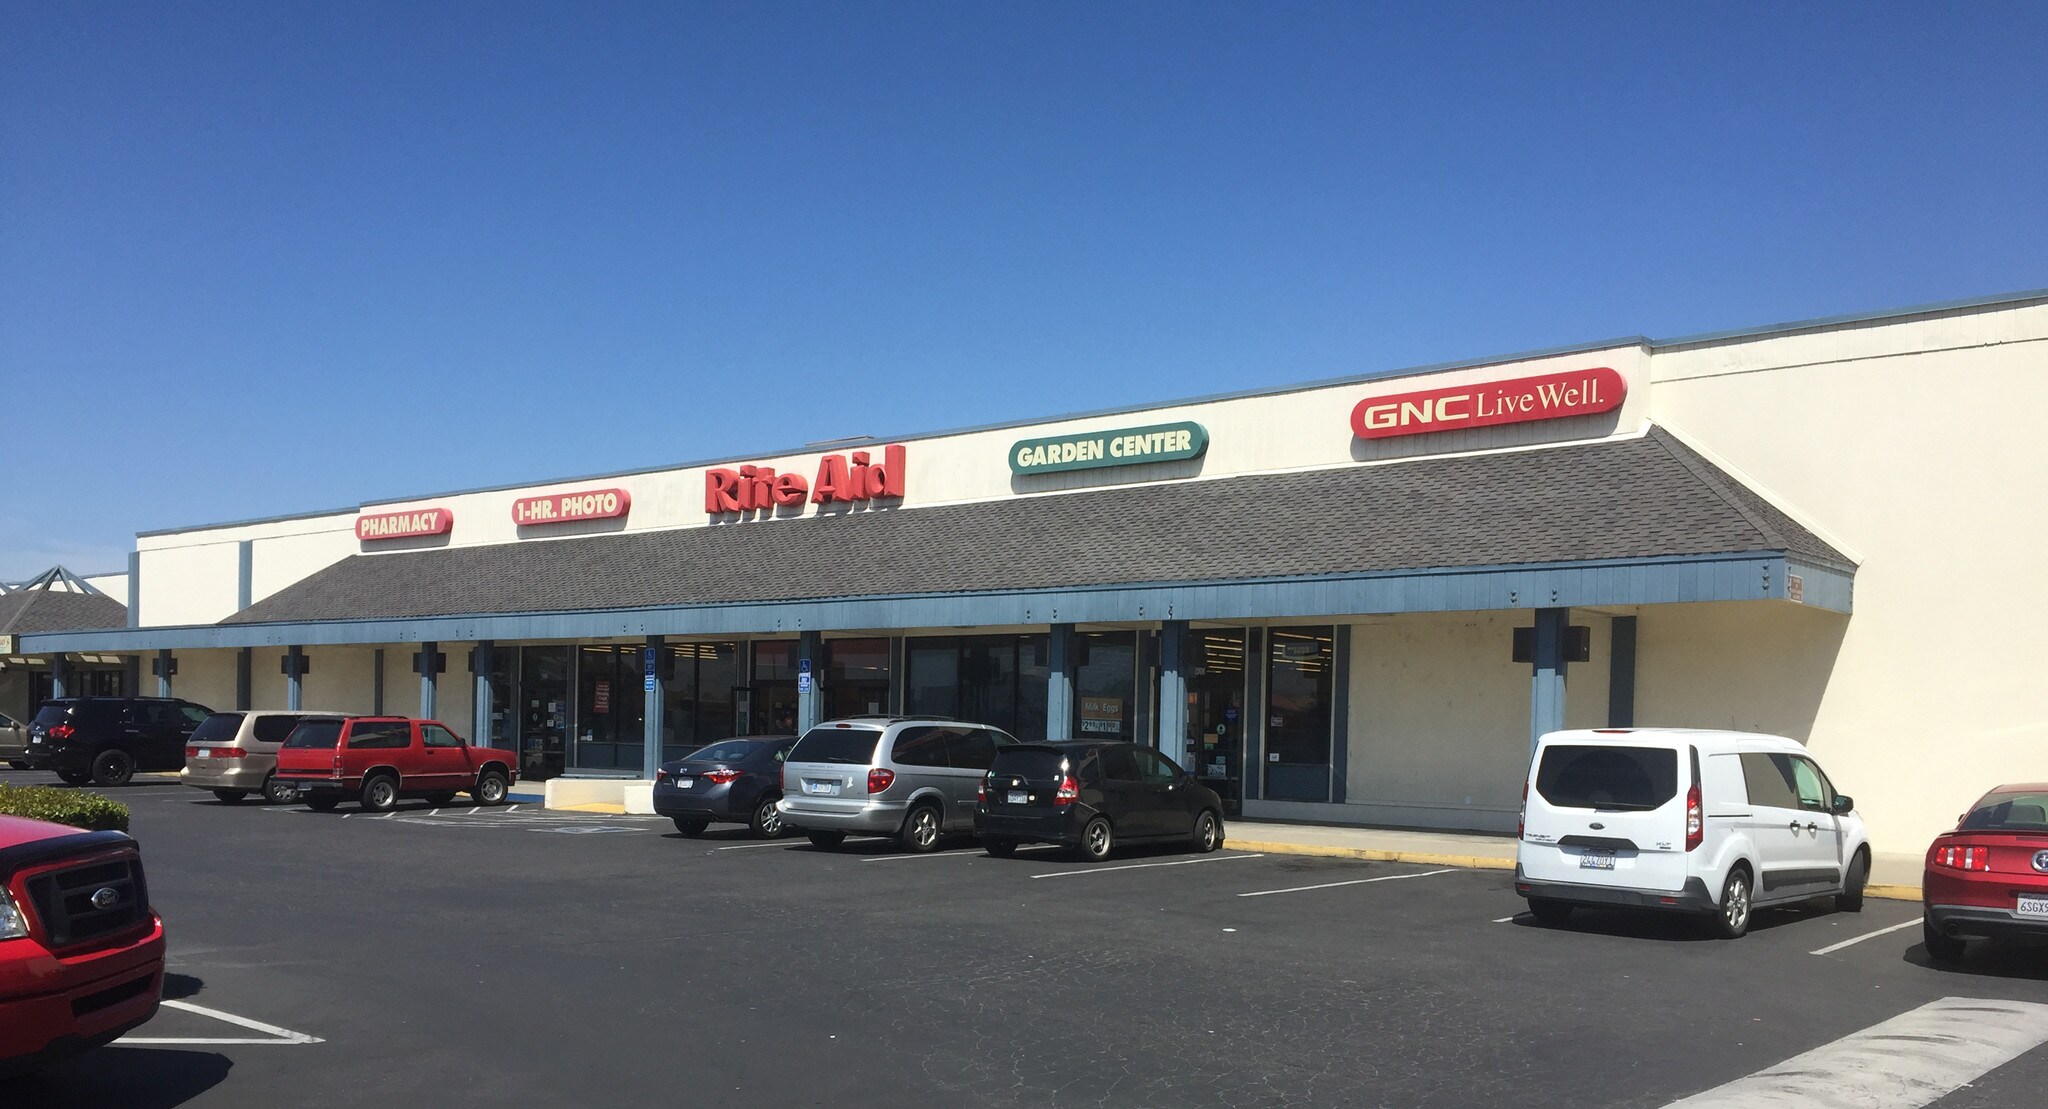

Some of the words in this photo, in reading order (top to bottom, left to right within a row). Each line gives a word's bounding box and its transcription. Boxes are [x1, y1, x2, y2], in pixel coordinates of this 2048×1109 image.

[1364, 394, 1470, 430] GNC
[1476, 389, 1534, 418] Live
[1536, 378, 1604, 409] Well.
[1017, 439, 1104, 467] GARDEN
[1110, 430, 1192, 458] CENTER
[705, 464, 808, 513] Rite
[811, 444, 906, 504] Aid
[361, 512, 439, 537] PHARMACY
[517, 499, 557, 521] 1-HR.
[561, 492, 618, 517] PHOTO
